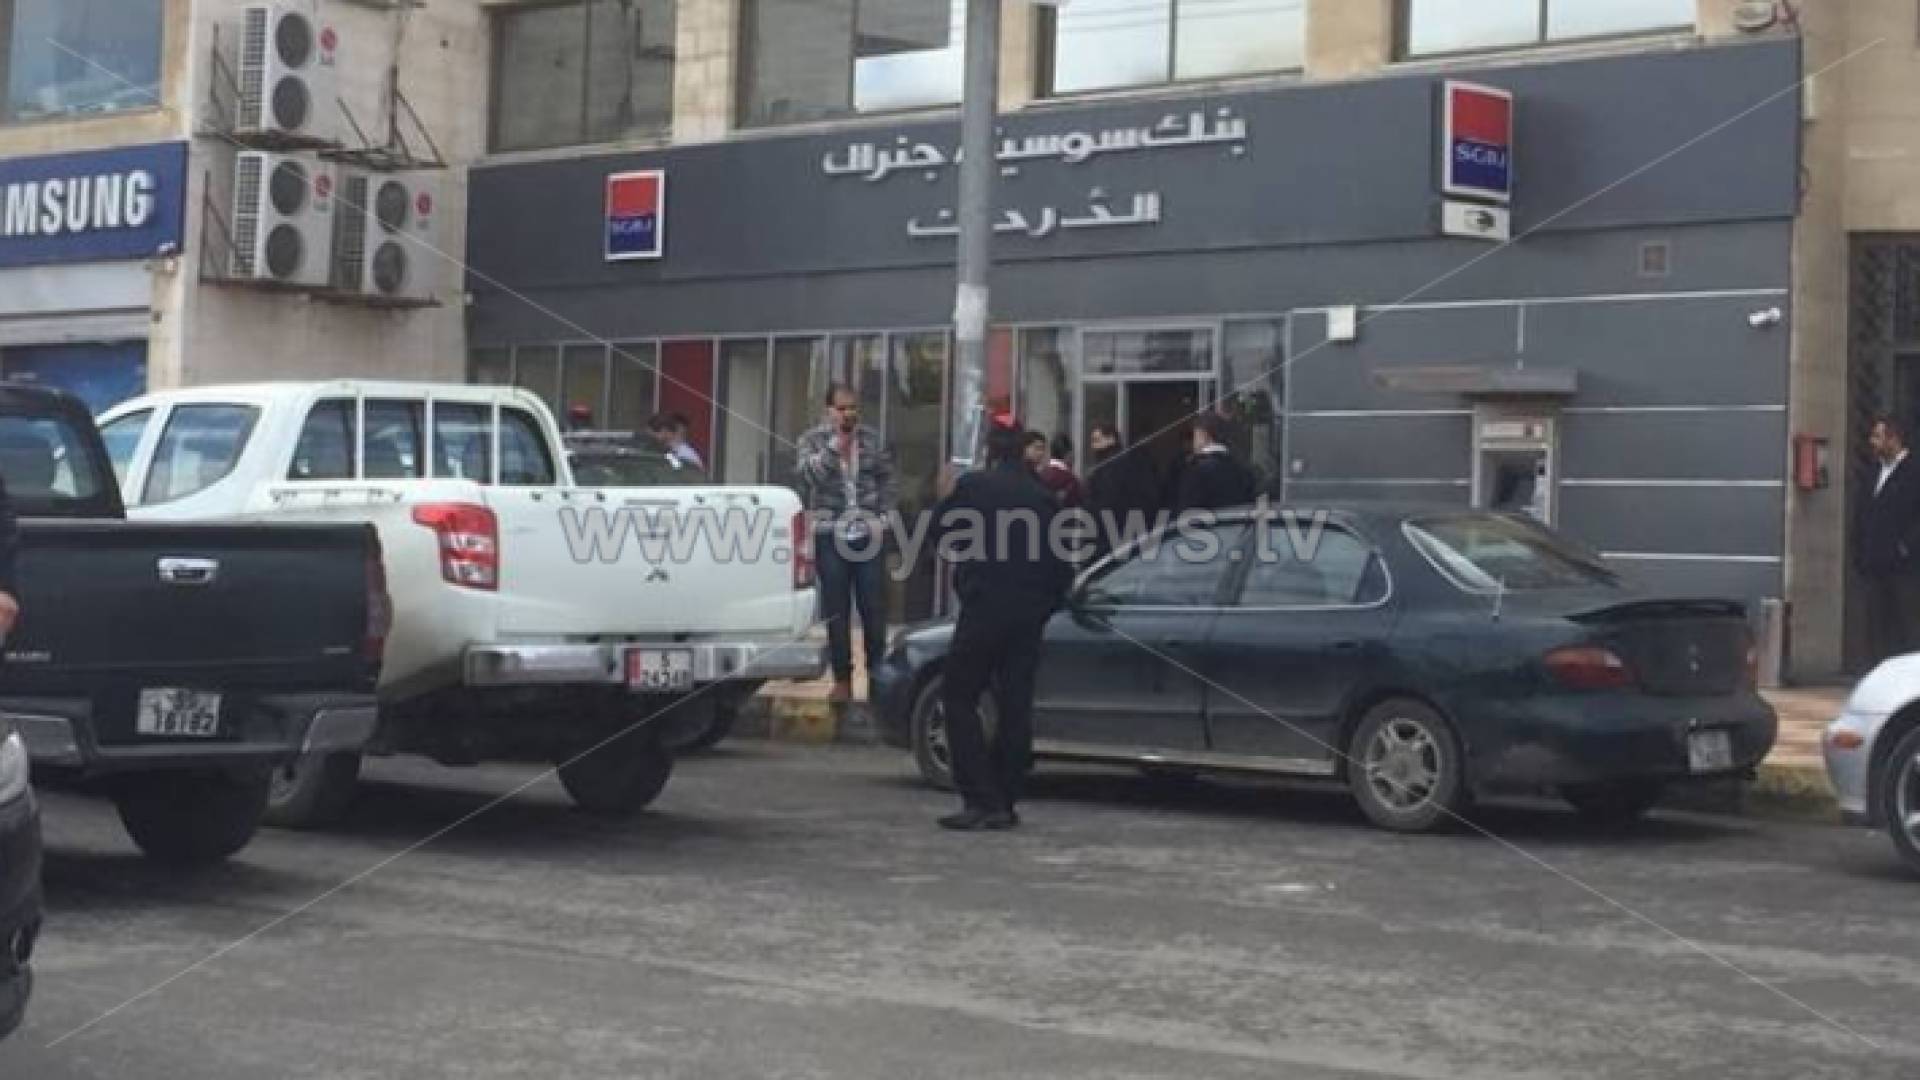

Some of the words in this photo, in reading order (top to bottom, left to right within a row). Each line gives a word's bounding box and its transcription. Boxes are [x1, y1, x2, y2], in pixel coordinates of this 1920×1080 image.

[954, 126, 1140, 177] سوسي
[1141, 106, 1246, 156] بنك
[822, 136, 946, 181] جنرال
[0, 169, 155, 235] MSUNG
